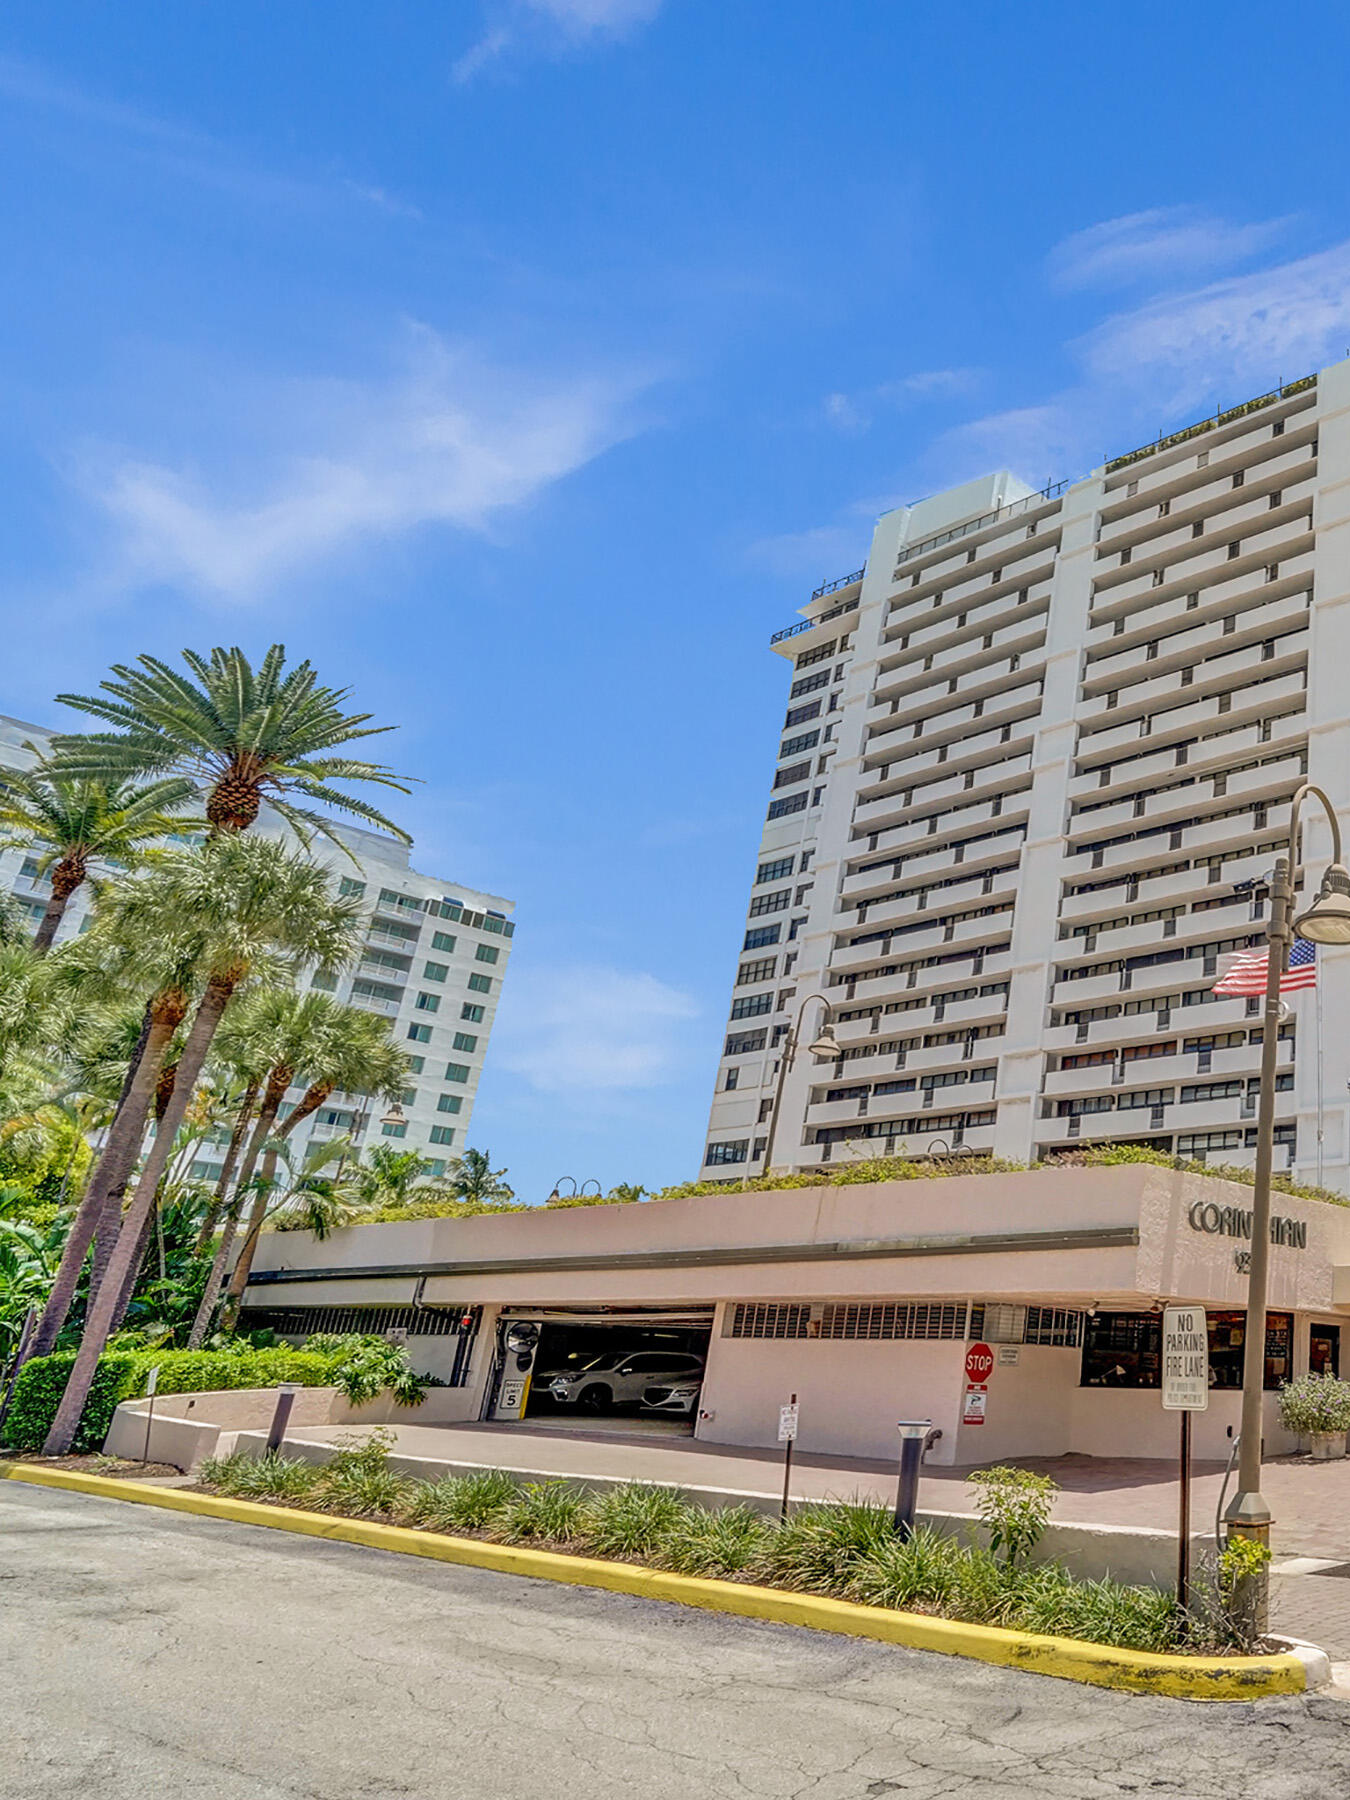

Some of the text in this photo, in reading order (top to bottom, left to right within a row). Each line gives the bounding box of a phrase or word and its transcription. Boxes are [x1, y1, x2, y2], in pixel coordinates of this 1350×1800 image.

[1177, 1314, 1193, 1332] NO
[1166, 1334, 1204, 1352] PARKING
[966, 1355, 992, 1371] STOP
[1166, 1356, 1204, 1377] FIRE LANE
[507, 1394, 516, 1406] 5
